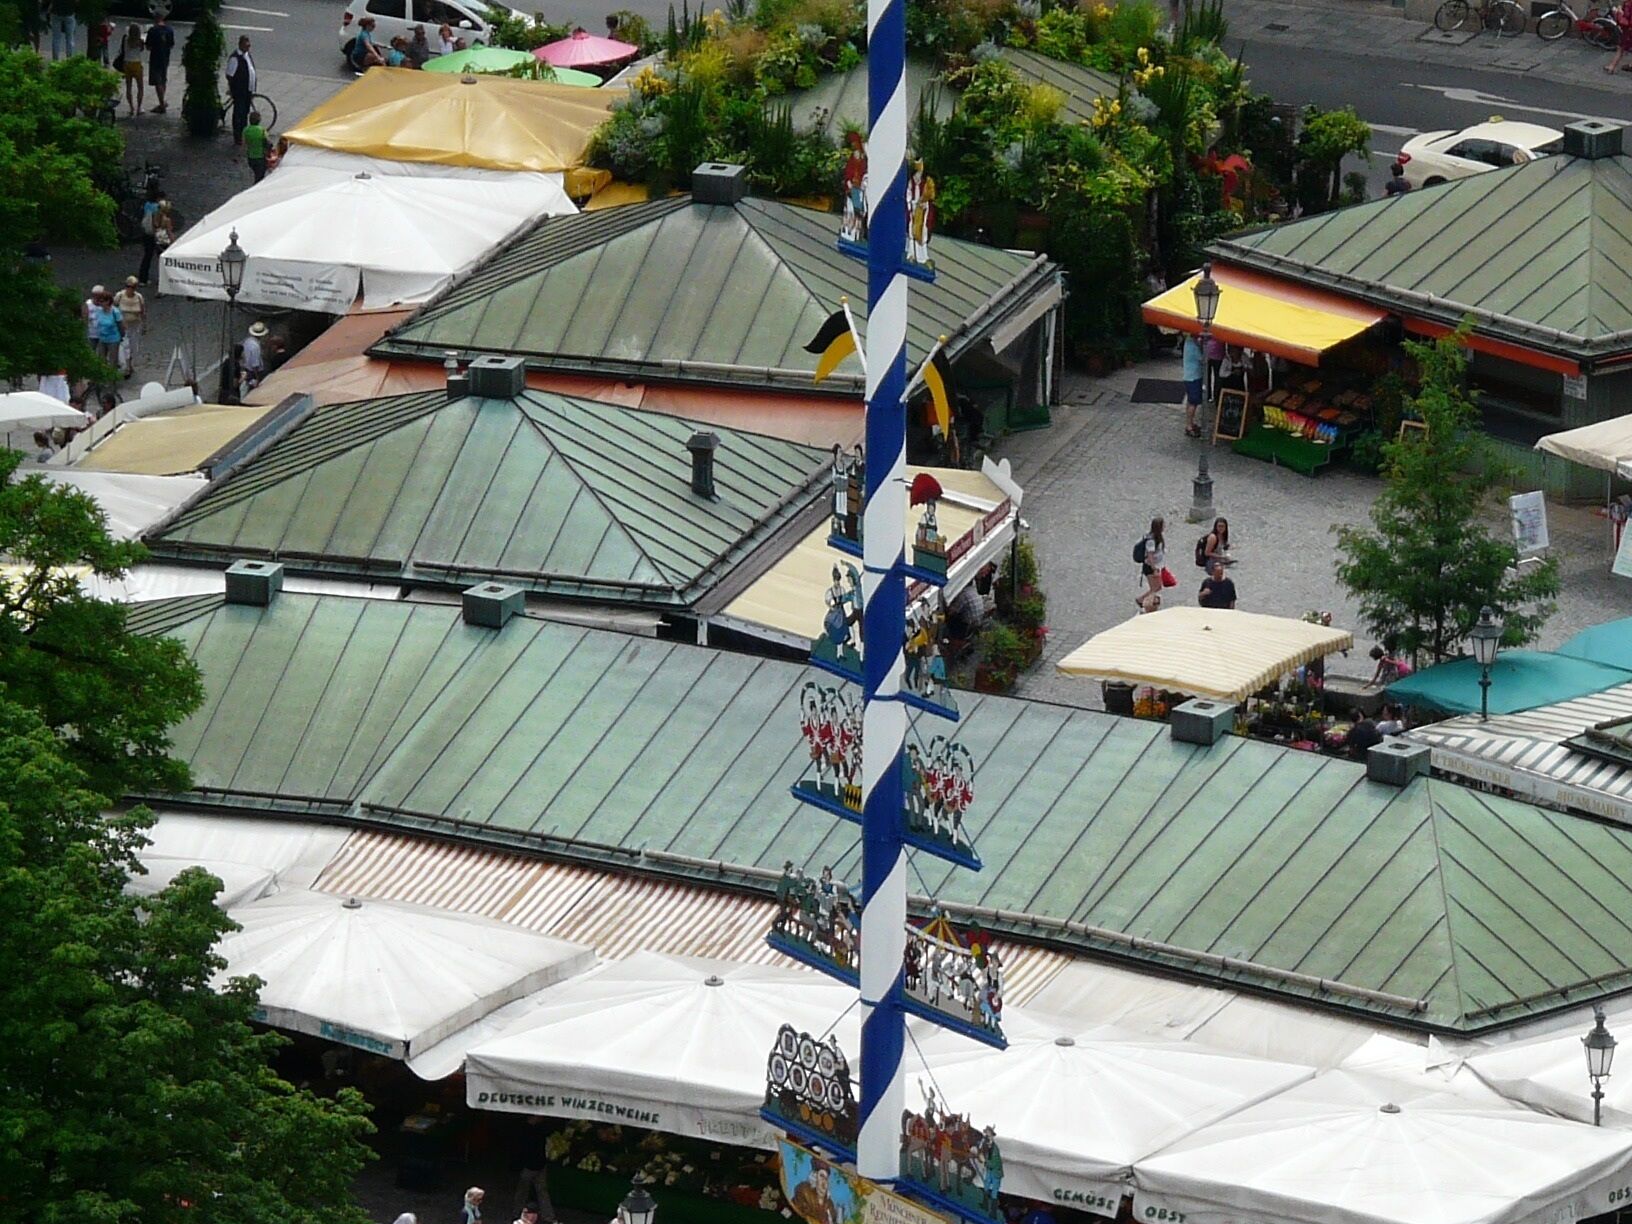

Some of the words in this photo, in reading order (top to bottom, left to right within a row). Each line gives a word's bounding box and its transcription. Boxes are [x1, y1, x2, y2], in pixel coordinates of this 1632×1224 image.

[164, 257, 212, 273] Blumen
[478, 1092, 555, 1107] DEUTSCHE
[561, 1097, 660, 1124] WINZERWEINE
[1053, 1188, 1115, 1211] GEMÜSE
[1145, 1206, 1187, 1224] OBST
